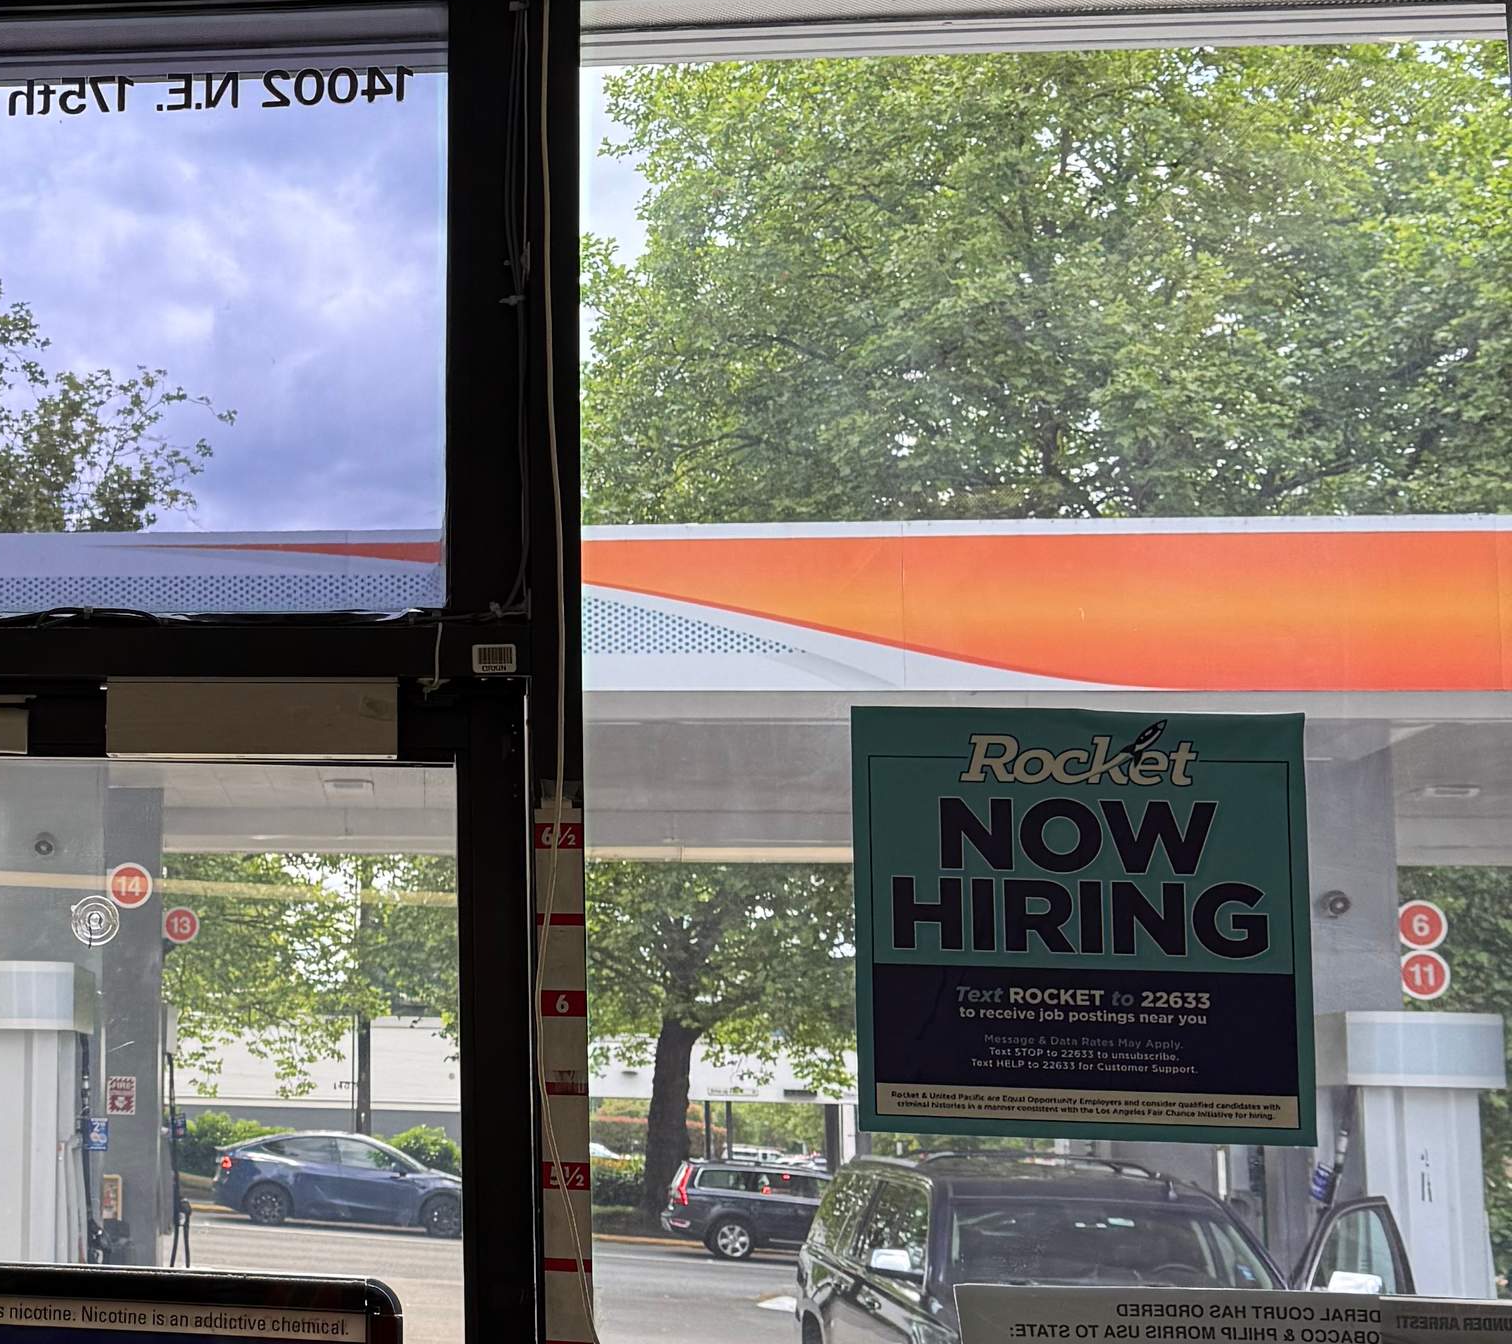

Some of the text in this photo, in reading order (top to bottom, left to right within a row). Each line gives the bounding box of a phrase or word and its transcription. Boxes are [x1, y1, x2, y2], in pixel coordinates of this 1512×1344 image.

[959, 731, 1200, 787] Rocket
[938, 796, 1219, 876] NOW
[117, 875, 142, 890] 14
[169, 916, 191, 933] 13
[890, 875, 1271, 959] HIRING
[1411, 913, 1431, 937] 6
[1409, 962, 1437, 987] 11
[555, 994, 569, 1014] 6
[955, 986, 1211, 1010] Text ROCKET to 22633
[959, 1006, 1207, 1027] to receive job postings near you
[989, 1047, 1180, 1062] Text STOP to 22633 to unsubscribe.
[8, 1303, 76, 1322] nicotine.
[81, 1305, 147, 1326] Nicotine
[151, 1309, 166, 1326] is
[169, 1314, 190, 1328] an
[194, 1312, 266, 1332] addictive
[270, 1316, 350, 1337] chemical.
